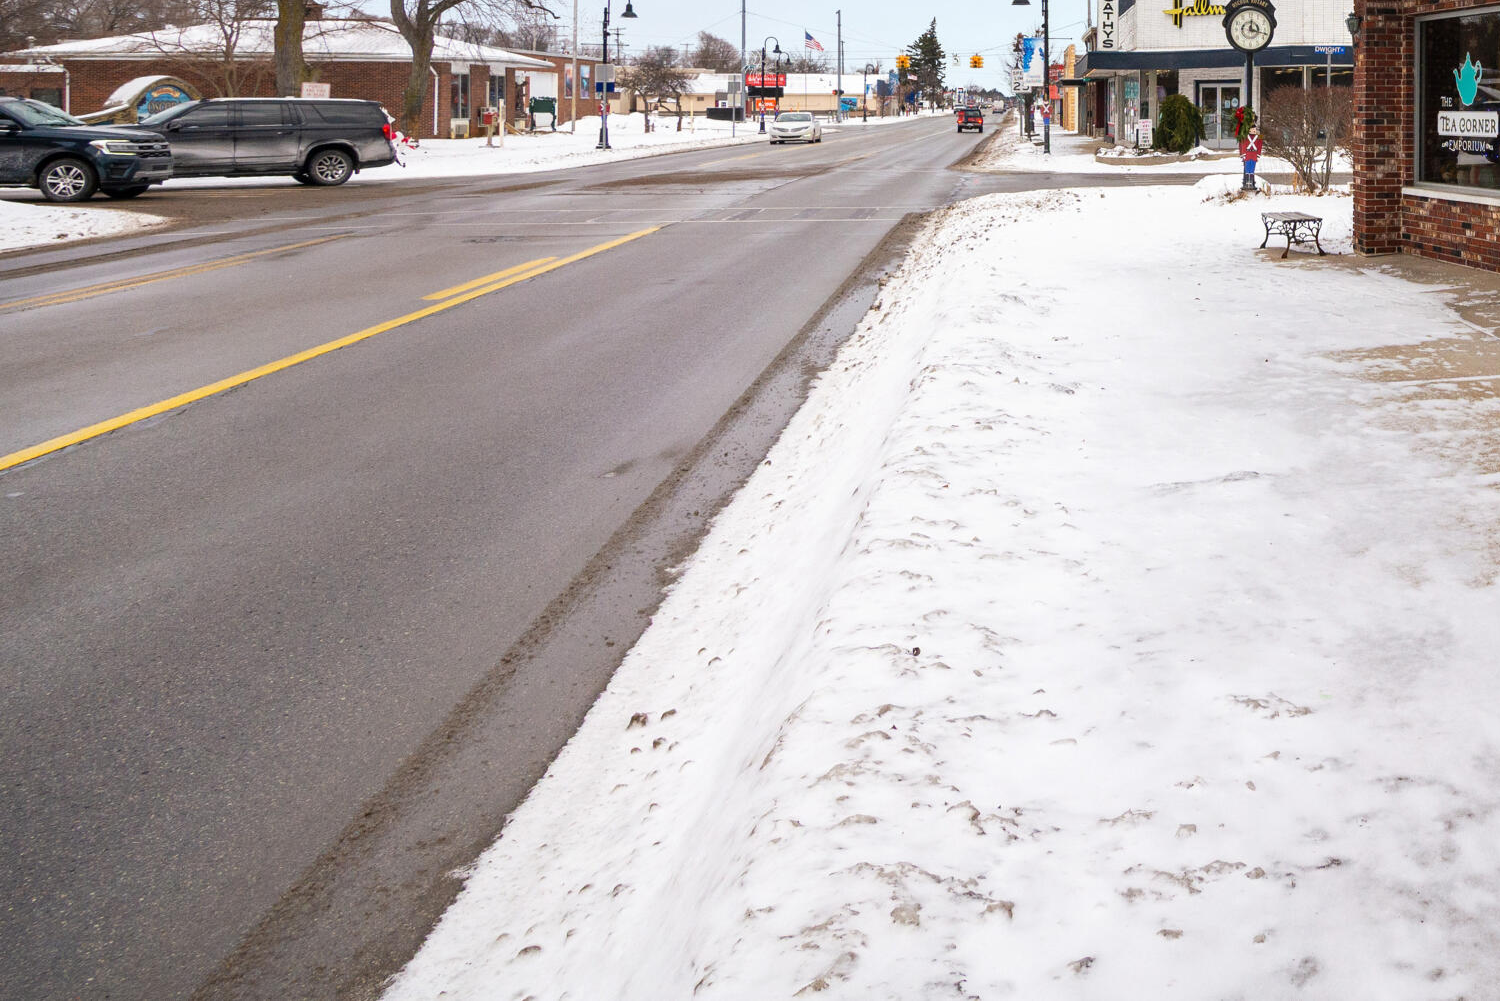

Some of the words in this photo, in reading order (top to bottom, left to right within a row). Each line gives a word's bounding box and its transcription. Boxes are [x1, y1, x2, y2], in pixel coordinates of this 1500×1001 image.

[1440, 96, 1453, 107] THE
[148, 102, 178, 114] OSCO
[1440, 116, 1456, 132] TEA
[1459, 118, 1496, 134] CORNER
[1448, 140, 1486, 152] EMPORIUM
